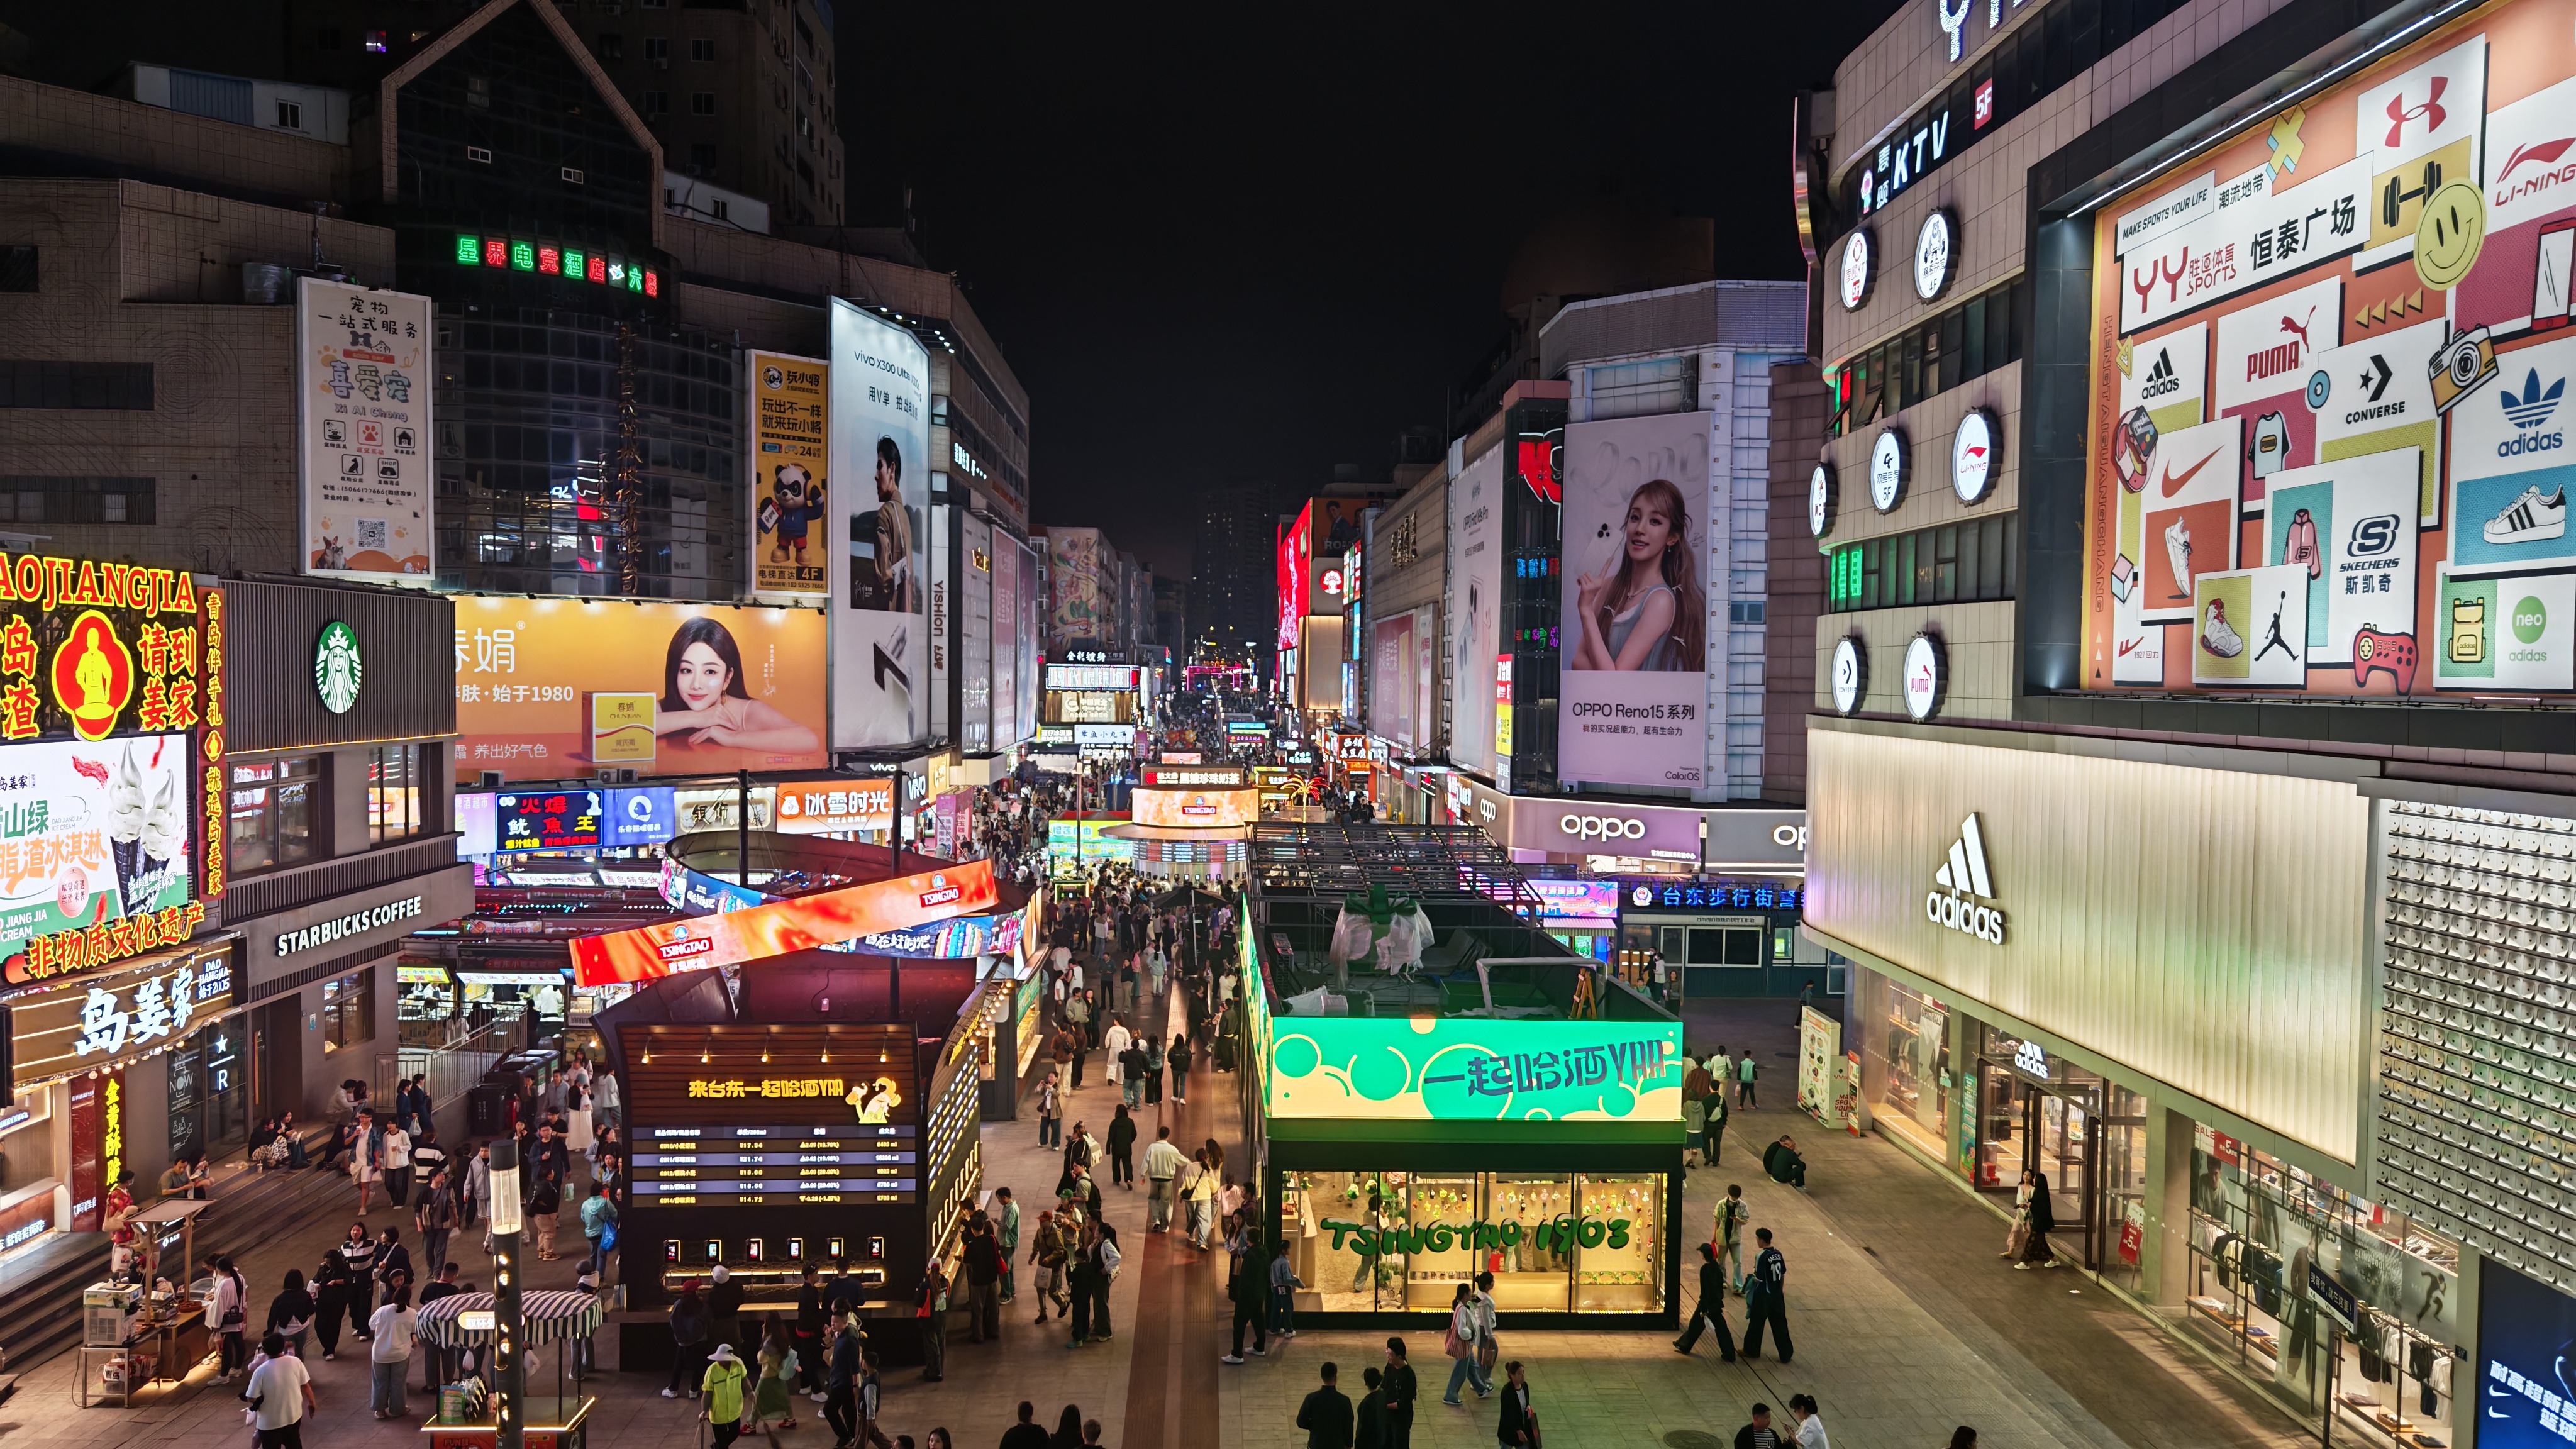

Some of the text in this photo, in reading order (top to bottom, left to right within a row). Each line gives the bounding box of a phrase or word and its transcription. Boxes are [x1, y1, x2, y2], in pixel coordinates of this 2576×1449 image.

[1976, 85, 1992, 121] 5F
[1893, 111, 1949, 189] KTV
[2219, 172, 2265, 210] 潮流地带
[2496, 163, 2576, 206] LI-NING
[2123, 188, 2208, 240] MAKE SPORTS YOUR LIFE
[2250, 194, 2357, 270] 恒泰广场
[458, 238, 604, 281] 星界电竞酒店
[2186, 264, 2236, 297] SPORTS
[350, 295, 388, 314] 宠物
[318, 314, 418, 338] 一站式服务
[854, 350, 910, 381] vivo X300 Ultra
[2246, 340, 2300, 383] PUMA
[328, 360, 411, 402] 喜爱宠
[787, 370, 820, 387] 玩小将
[2141, 374, 2179, 400] adidas
[869, 386, 889, 406] 用V单
[335, 403, 408, 422] Xi Ai Chong
[762, 398, 821, 418] 玩出不一样
[2346, 401, 2406, 425] CONVERSE
[762, 414, 821, 434] 就来玩小将
[800, 446, 811, 456] 24
[2497, 430, 2563, 458] adidas
[1960, 462, 1987, 474] LI-NING
[1883, 487, 1891, 501] 5F
[759, 568, 818, 579] 电梯直达 4F
[2339, 558, 2399, 572] SKECHERS
[2345, 573, 2392, 595] 斯凯奇
[2516, 613, 2542, 628] neo
[0, 614, 39, 679] 岛
[137, 621, 197, 677] 请到
[2509, 648, 2547, 662] adidas
[206, 592, 223, 726] 青岛伴手礼
[1053, 670, 1124, 686] 现代眼镜城
[1911, 678, 1929, 693] PUMA
[138, 676, 199, 731] 姜家
[455, 685, 574, 703] 肤·始于1980
[0, 677, 40, 739] 渣
[618, 702, 634, 712] 春娟
[1572, 702, 1695, 720] OPPO Reno15 系列
[1643, 726, 1682, 736] 超有生命力
[475, 743, 548, 759] 养出好气色
[870, 763, 897, 772] vivo
[1179, 772, 1240, 784] 黑糖珍珠奶茶
[1665, 771, 1699, 781] ColorOS
[908, 771, 926, 800] vivo
[519, 796, 567, 814] 火爆
[805, 791, 889, 816] 冰雪时光
[1480, 798, 1496, 823] oppo
[0, 800, 49, 838] 山绿
[1561, 814, 1645, 841] oppo
[206, 766, 223, 896] 就选岛姜家
[923, 888, 959, 905] TSINGTAO
[1663, 887, 1804, 909] 台东步行街警
[6, 913, 32, 928] JIANG
[34, 909, 47, 922] JIA
[279, 896, 421, 957] STARBUCKS COFFEE
[1926, 888, 2007, 945] adidas
[1, 925, 32, 942] CREAM
[29, 902, 204, 979] 非物质文化遗产
[865, 933, 931, 952] 自在好时光
[660, 940, 709, 958] TSINGTAO
[205, 958, 221, 973] DAO
[74, 968, 194, 1056] 岛姜家
[2014, 1053, 2048, 1079] adidas
[218, 1069, 228, 1091] R
[105, 1078, 121, 1194] 金黄酥脆
[2195, 1124, 2215, 1140] SALE
[1321, 1213, 1631, 1255] TSINGTAO 1903
[2126, 1214, 2143, 1233] SALE
[1770, 1262, 1782, 1282] 19
[2490, 1360, 2576, 1424] 耐高超新星
